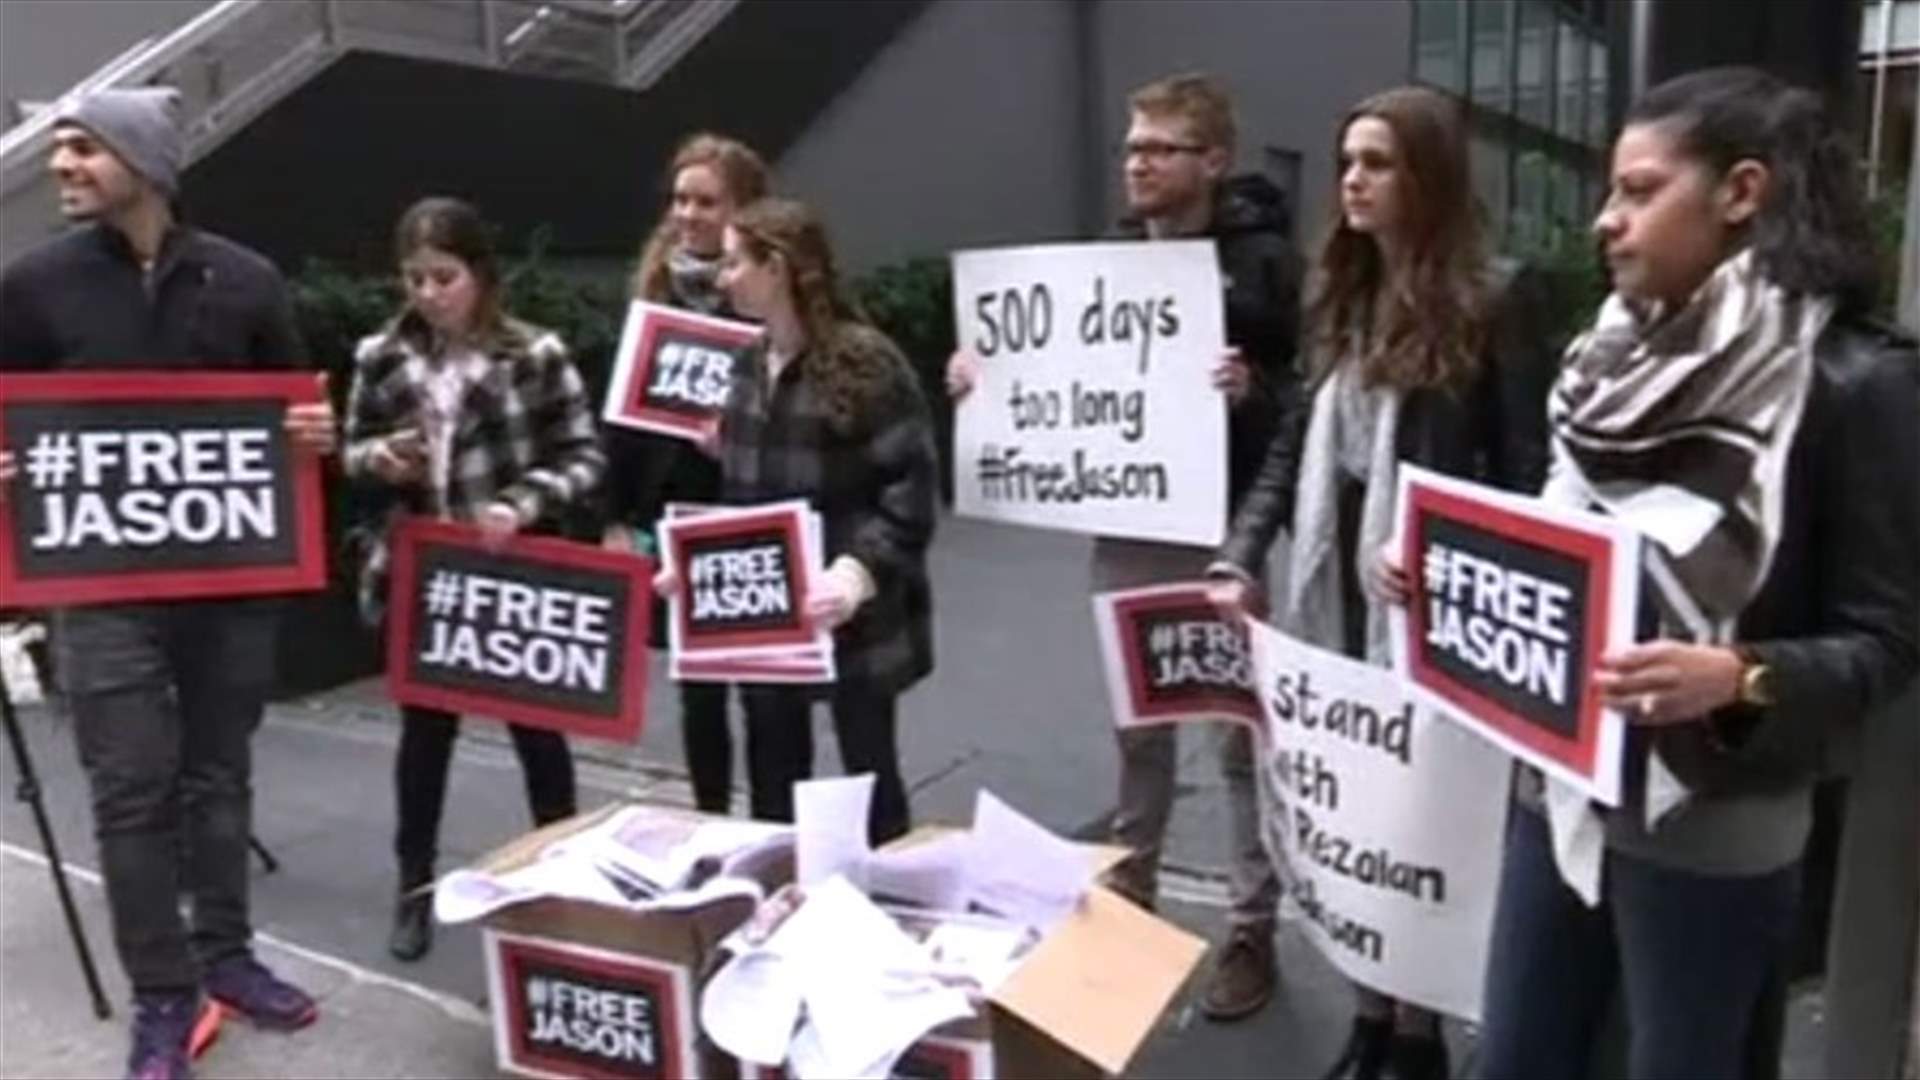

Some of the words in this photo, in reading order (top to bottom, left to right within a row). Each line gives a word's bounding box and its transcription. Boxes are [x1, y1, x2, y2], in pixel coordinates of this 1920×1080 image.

[976, 282, 1052, 357] 500
[1079, 276, 1180, 374] days
[1008, 381, 1061, 430] too
[1071, 381, 1145, 441] long
[24, 429, 274, 487] #FREE
[31, 487, 277, 548] JASON
[689, 545, 785, 584] #FREE
[1422, 543, 1572, 644] #FREE
[426, 569, 612, 644] #FREE
[691, 581, 790, 620] JASON
[420, 619, 607, 693] JASON
[1152, 651, 1254, 690] JASO
[1426, 598, 1567, 705] JASON
[1272, 671, 1415, 765] stand
[528, 974, 649, 1030] #FREE
[529, 1010, 655, 1065] JASON
